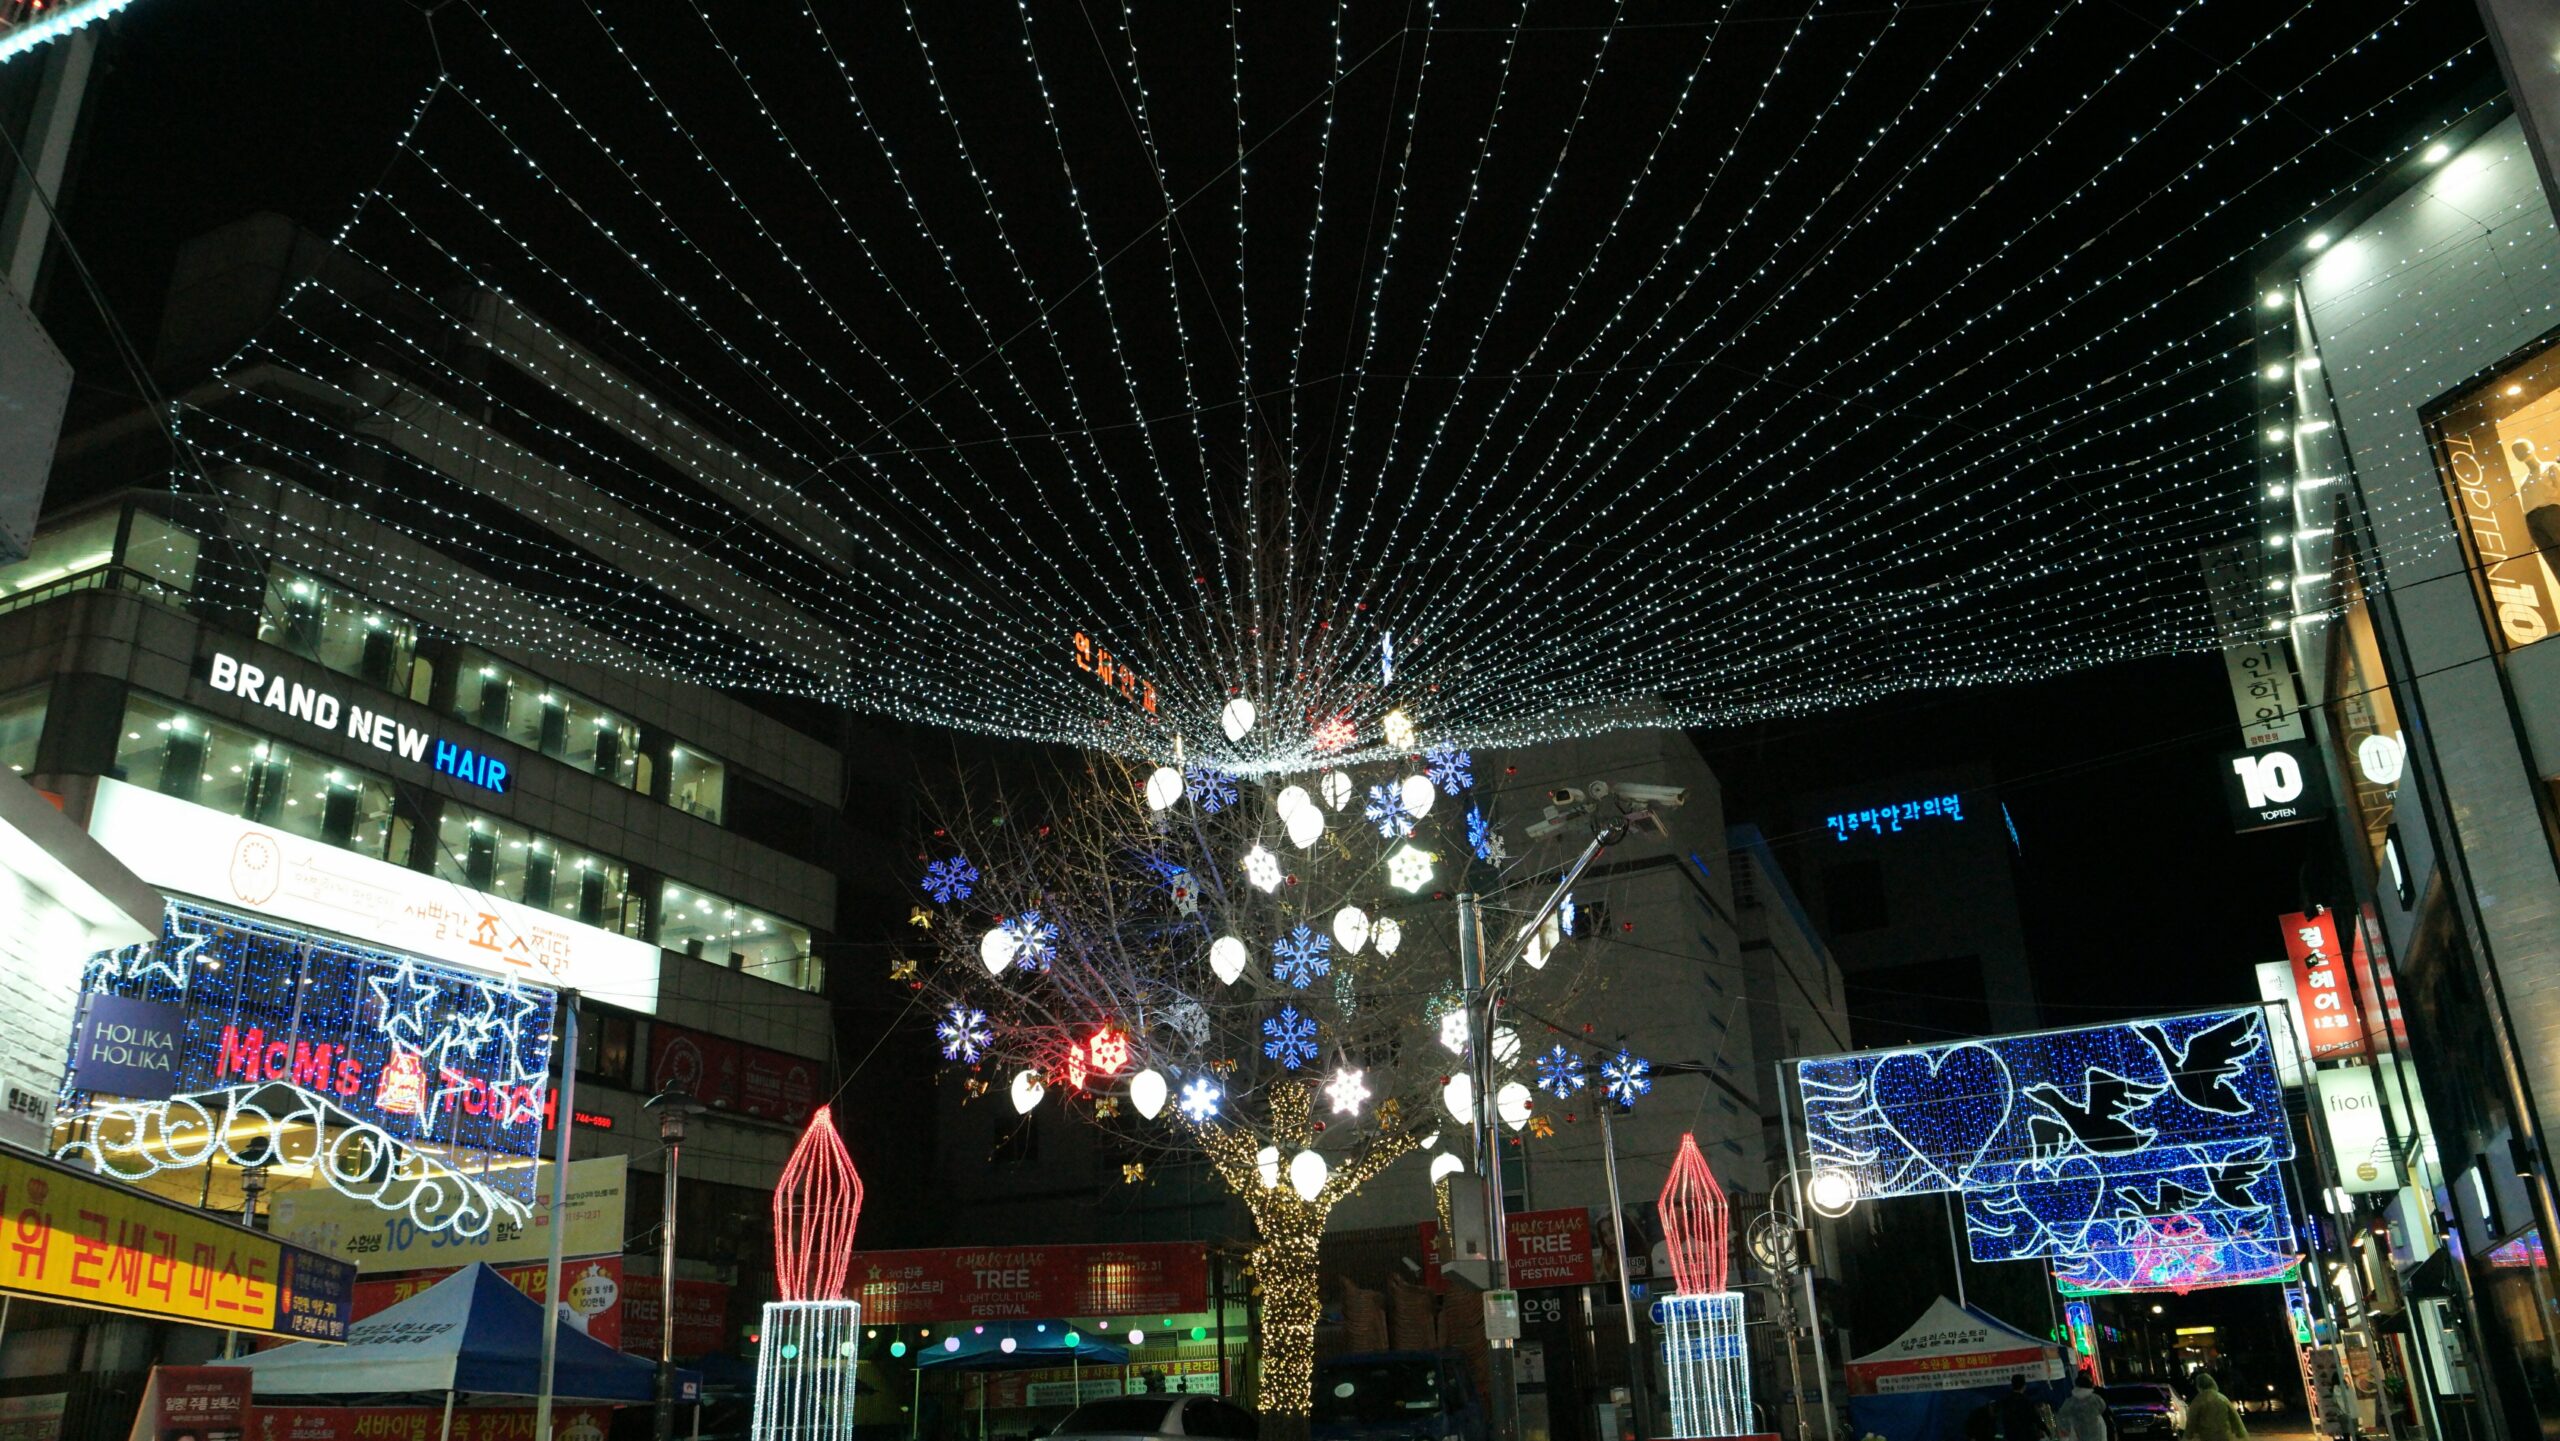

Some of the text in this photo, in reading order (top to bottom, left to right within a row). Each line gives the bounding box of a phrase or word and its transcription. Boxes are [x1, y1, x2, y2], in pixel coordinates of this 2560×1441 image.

[2445, 435, 2549, 645] TOPTEN 10
[210, 653, 508, 793] BRAND NEW HAIR
[2233, 752, 2303, 809] 10
[1827, 794, 1964, 842] 진주박안과의원
[2261, 808, 2296, 821] TOPTEN
[405, 901, 469, 940] 새빨간
[96, 1022, 174, 1051] HOLIKA
[92, 1044, 170, 1072] HOLIKA
[440, 1068, 559, 1131] TOUCH
[2330, 1091, 2373, 1112] fiori
[346, 1233, 382, 1253] 수험생
[1518, 1233, 1572, 1254] TREE
[71, 1209, 178, 1303] 굳세라
[189, 1243, 266, 1315] 미스트
[956, 1252, 1045, 1268] CHRISTMAS
[1508, 1253, 1585, 1270] LIGHT CULTURE
[972, 1269, 1031, 1289] TREE
[1520, 1267, 1574, 1281] FESTIVAL
[863, 1280, 944, 1295] 크리스마스트리
[960, 1290, 1042, 1304] LIGHT CULTURE
[623, 1299, 659, 1320] TREE
[971, 1303, 1029, 1316] FESTIVAL
[1522, 1298, 1560, 1323] 은행
[353, 1414, 428, 1441] 서바이벌
